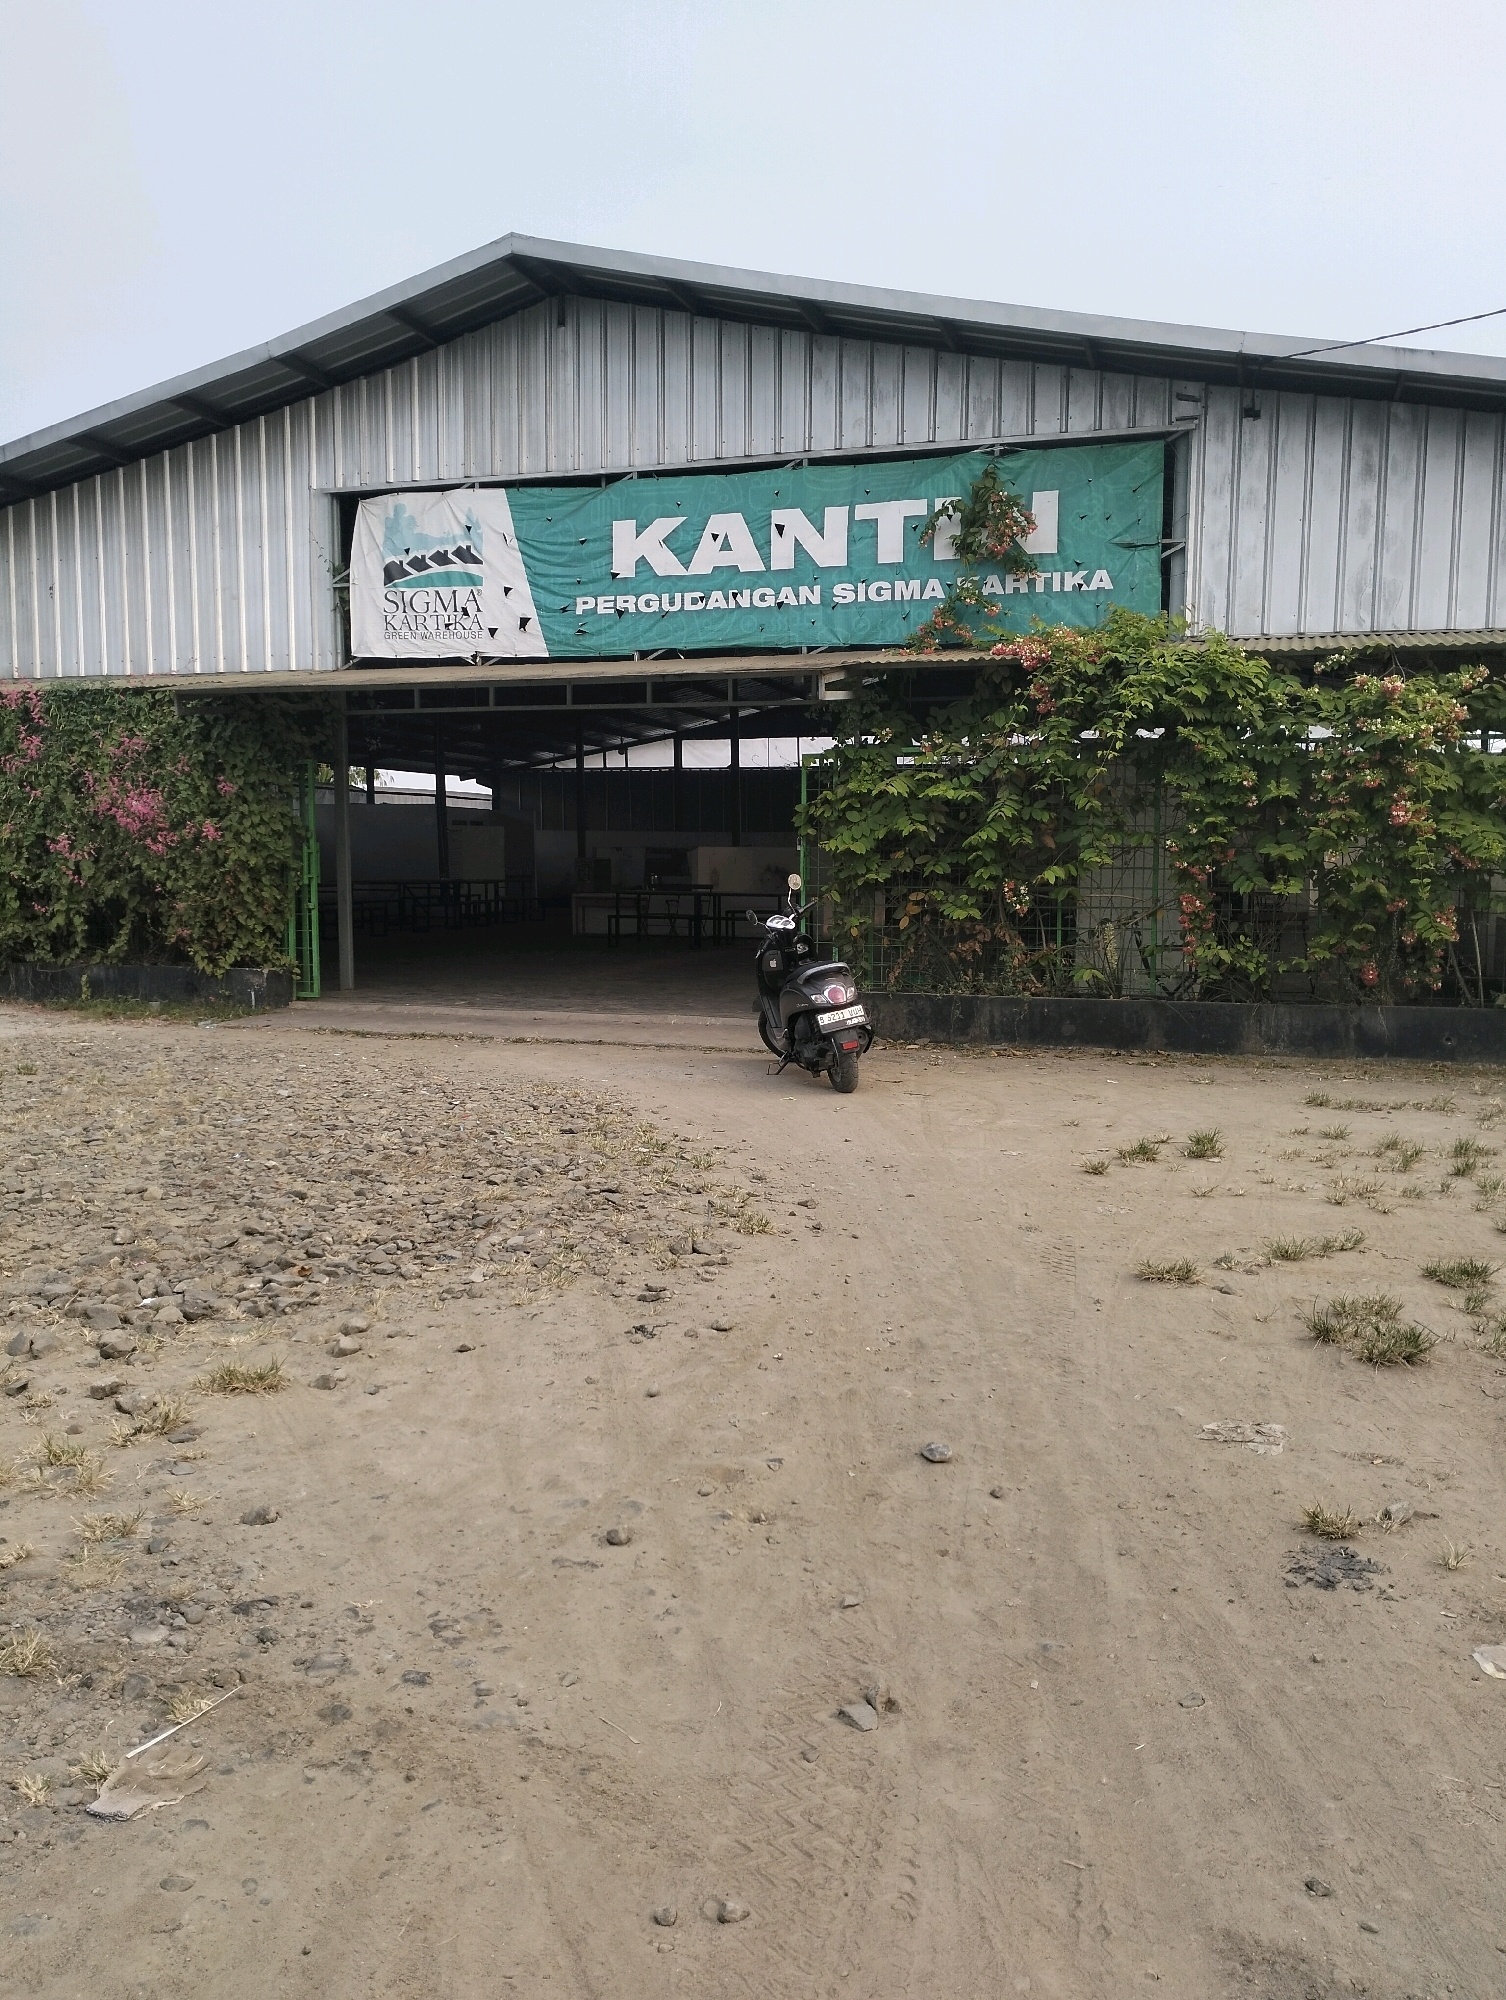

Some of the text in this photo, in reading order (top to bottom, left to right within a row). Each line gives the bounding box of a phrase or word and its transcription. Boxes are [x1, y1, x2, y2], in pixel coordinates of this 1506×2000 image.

[383, 589, 483, 614] SIGMA
[576, 585, 821, 615] PERGUDANGAN
[832, 578, 945, 604] SIGMA
[384, 630, 483, 640] GREEN WAREHOUSE
